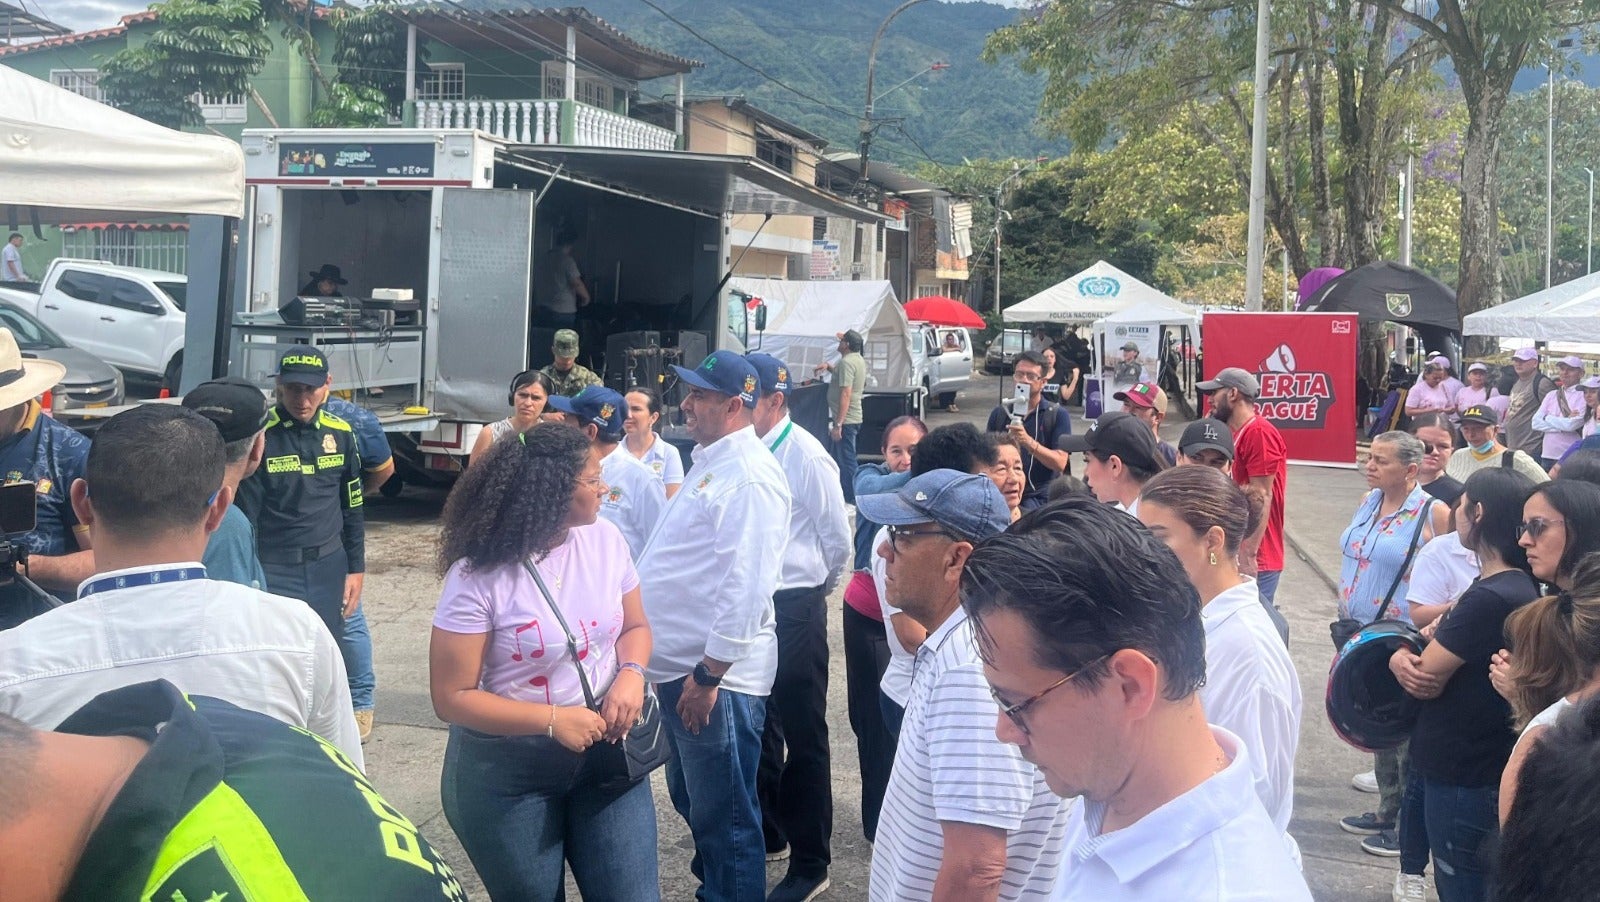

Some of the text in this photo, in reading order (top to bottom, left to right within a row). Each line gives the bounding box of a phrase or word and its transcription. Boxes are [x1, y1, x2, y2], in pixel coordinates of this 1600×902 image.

[1073, 311, 1103, 319] NACIONAL
[282, 355, 323, 368] POLICÍA
[1254, 373, 1330, 399] ERTA
[1252, 398, 1318, 420] BAGUÉ
[1204, 423, 1218, 440] LA
